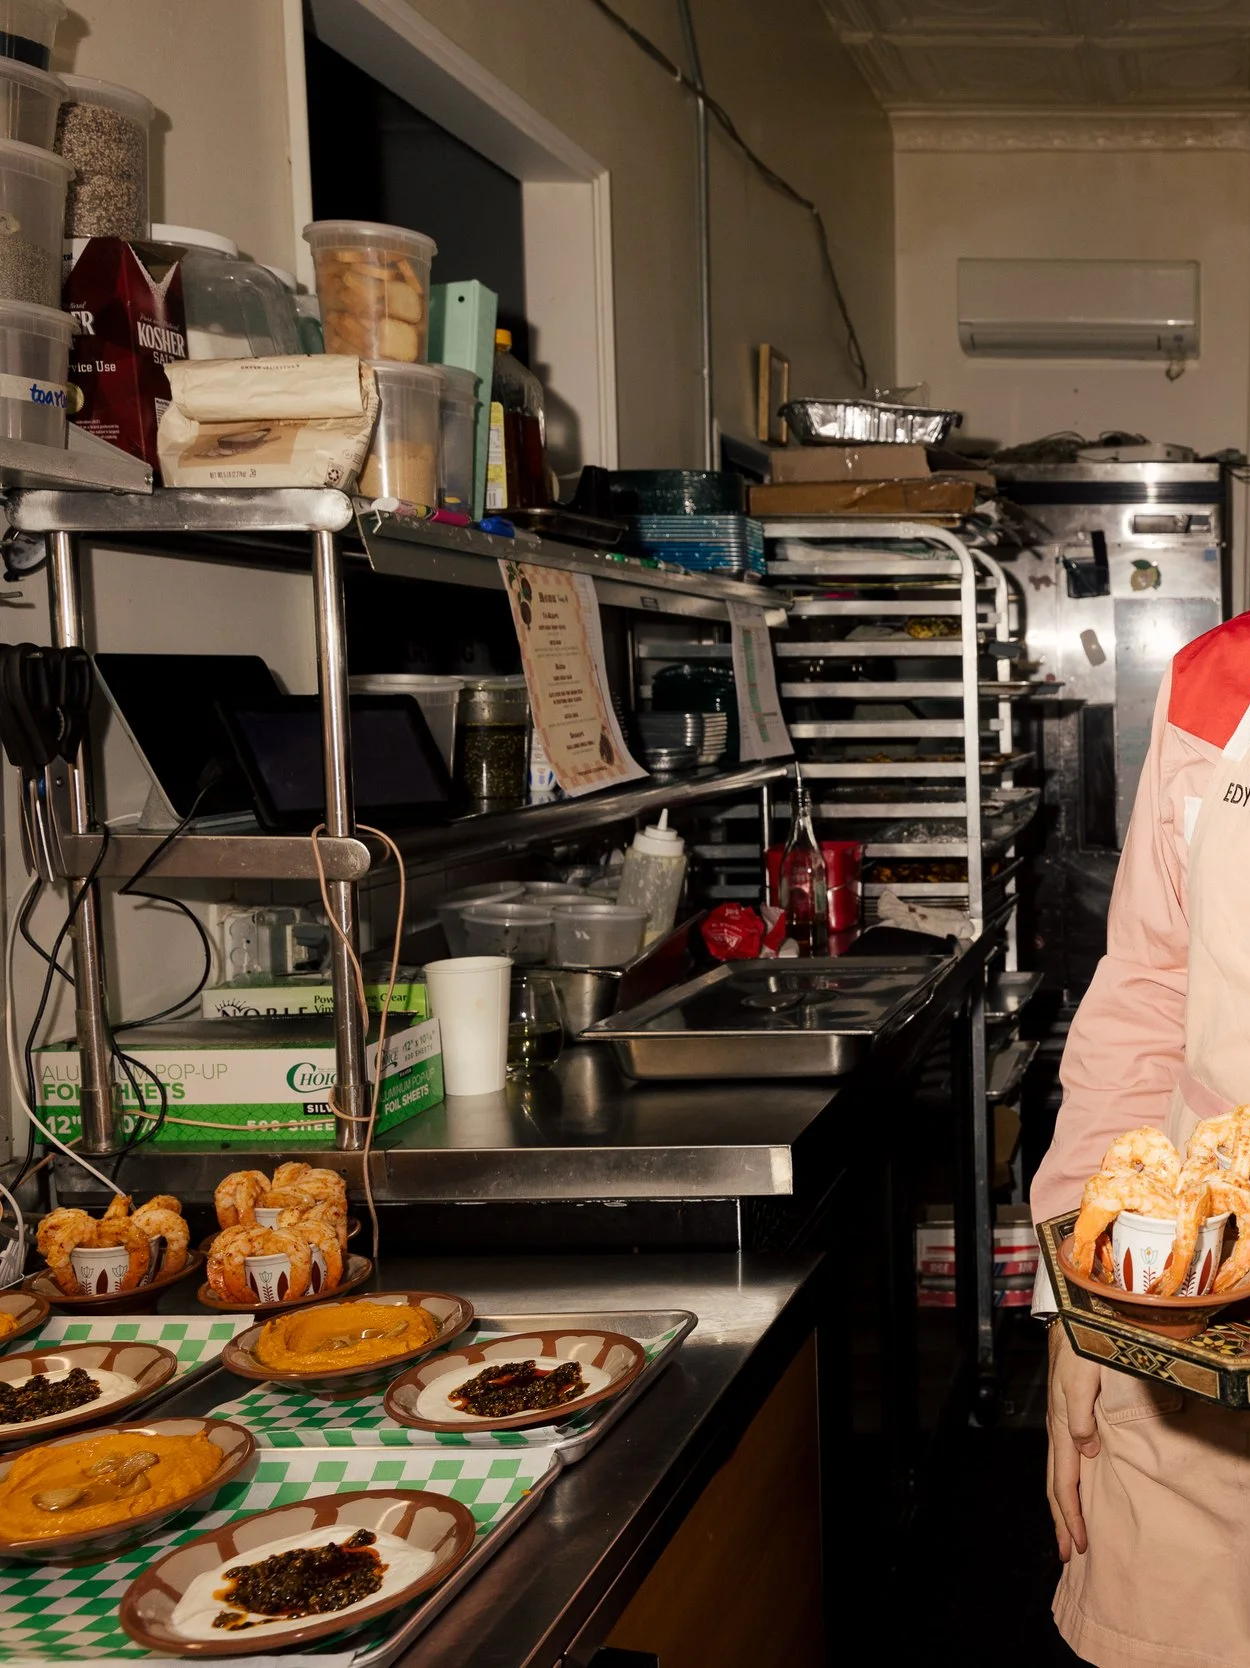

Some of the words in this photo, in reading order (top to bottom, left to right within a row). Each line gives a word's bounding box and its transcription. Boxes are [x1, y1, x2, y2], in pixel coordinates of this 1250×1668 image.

[136, 321, 186, 358] KOSHER
[95, 360, 117, 373] Use
[155, 1063, 228, 1081] POP-UP
[384, 1099, 402, 1115] FOIL
[401, 1084, 430, 1106] SHEETS
